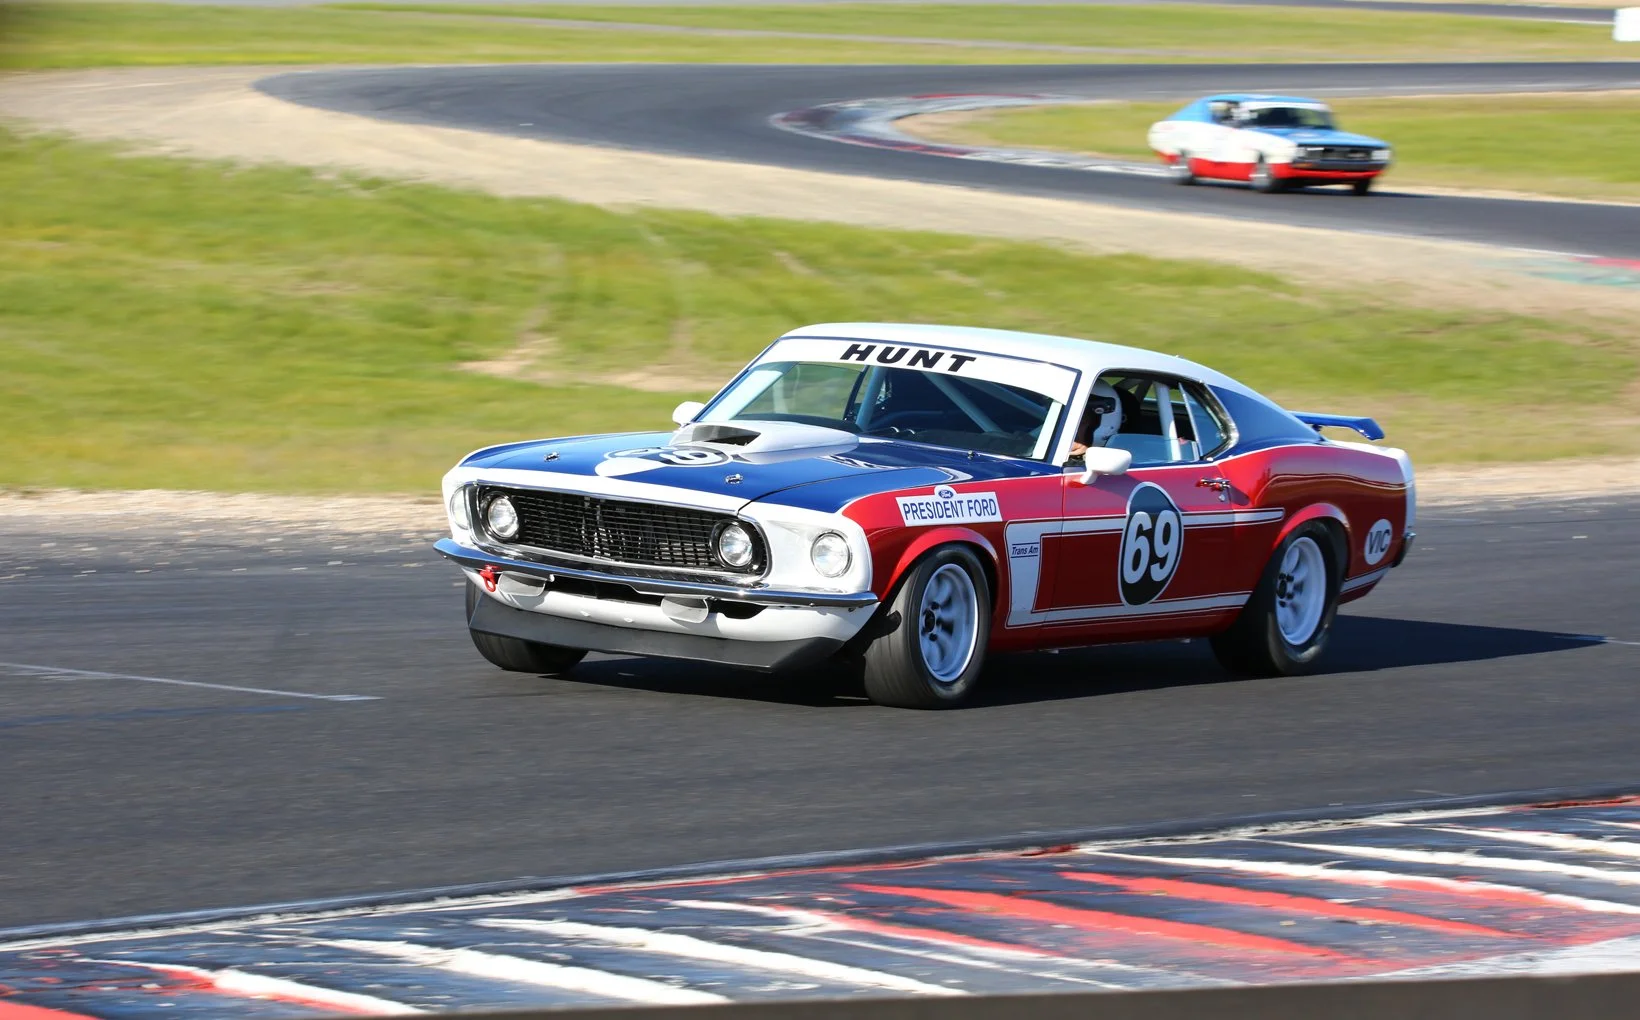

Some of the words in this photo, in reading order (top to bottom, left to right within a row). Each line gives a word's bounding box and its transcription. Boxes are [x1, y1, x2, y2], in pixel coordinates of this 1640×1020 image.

[840, 344, 977, 372] HUNT
[903, 501, 964, 520] PRESIDENT
[967, 498, 997, 517] FORD
[1011, 546, 1027, 555] Trans
[1028, 545, 1039, 554] Am
[1123, 509, 1180, 584] 69
[1368, 529, 1390, 554] VIC
